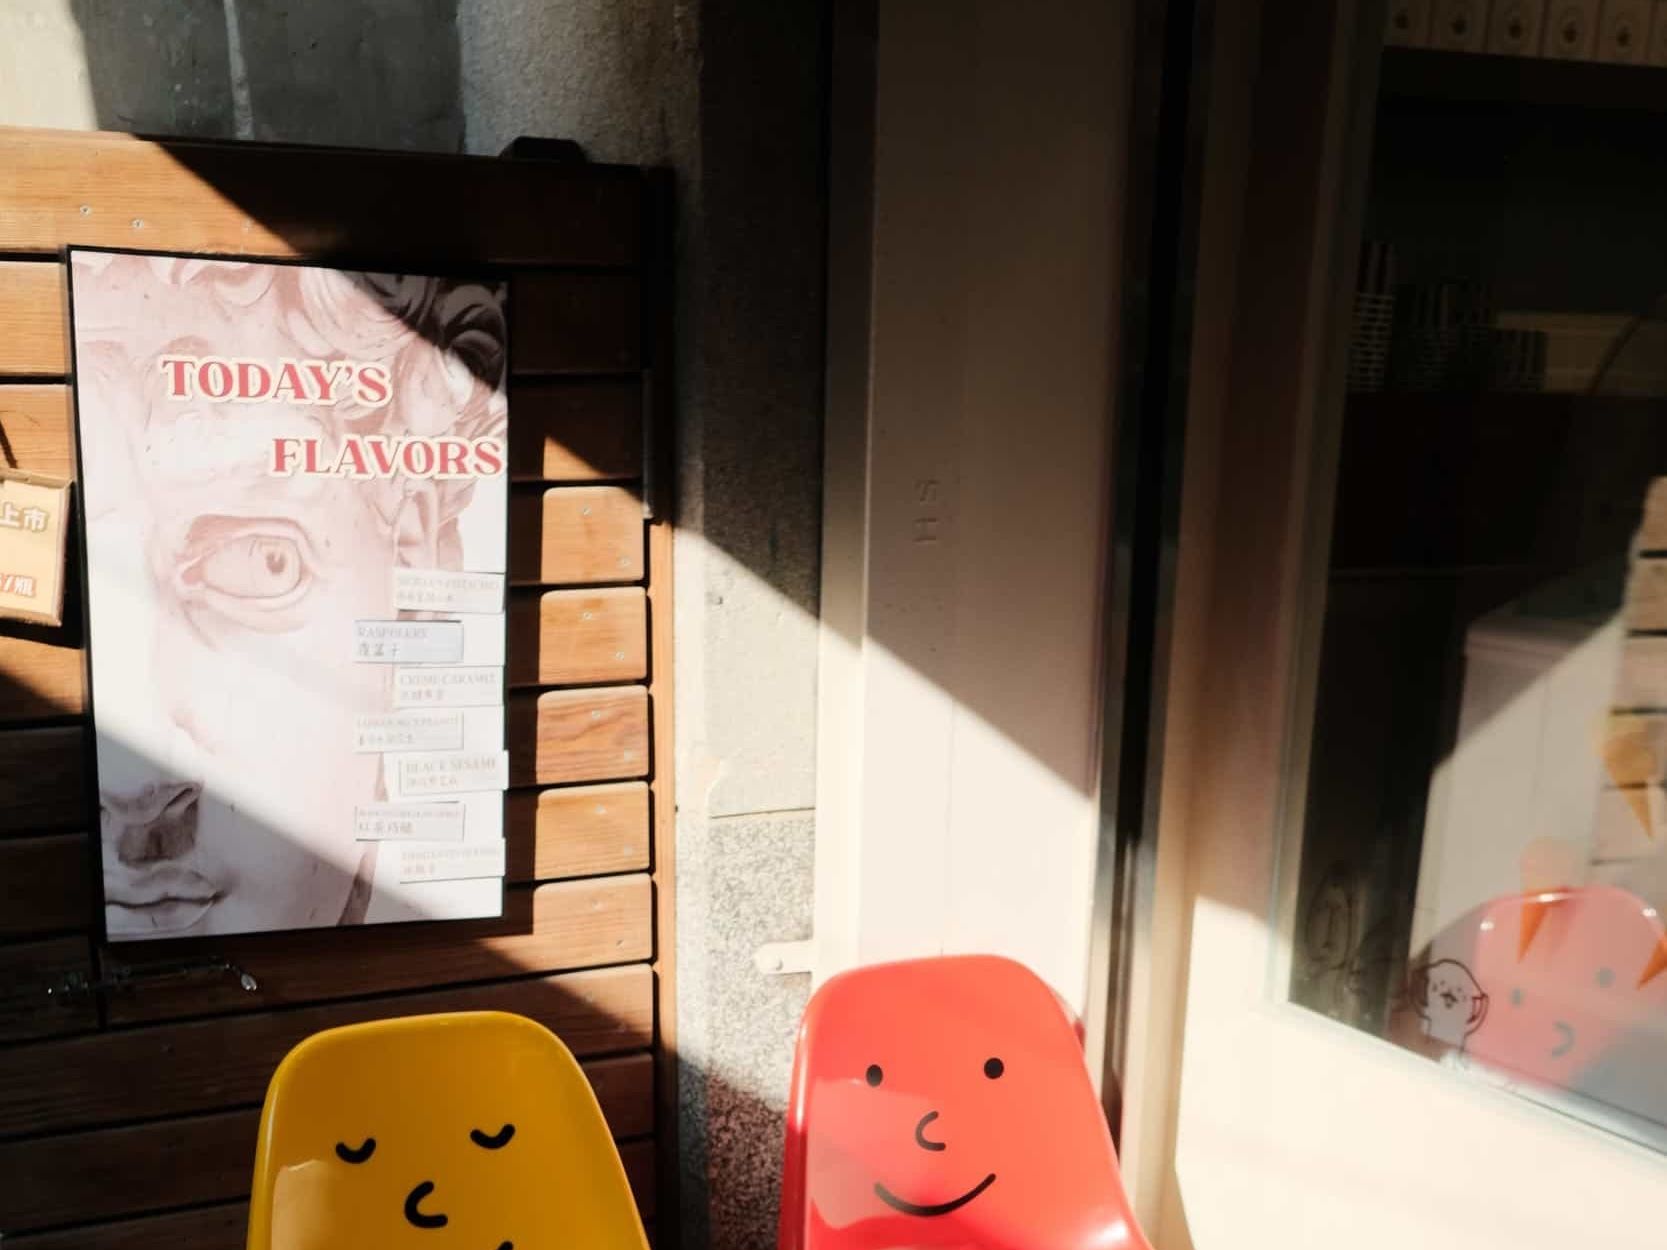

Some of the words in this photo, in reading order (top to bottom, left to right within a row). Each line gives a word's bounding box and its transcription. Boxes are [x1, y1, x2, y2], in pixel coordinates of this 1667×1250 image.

[161, 358, 388, 403] TODAY'S
[272, 437, 503, 476] FLAVORS
[0, 502, 48, 532] 上市
